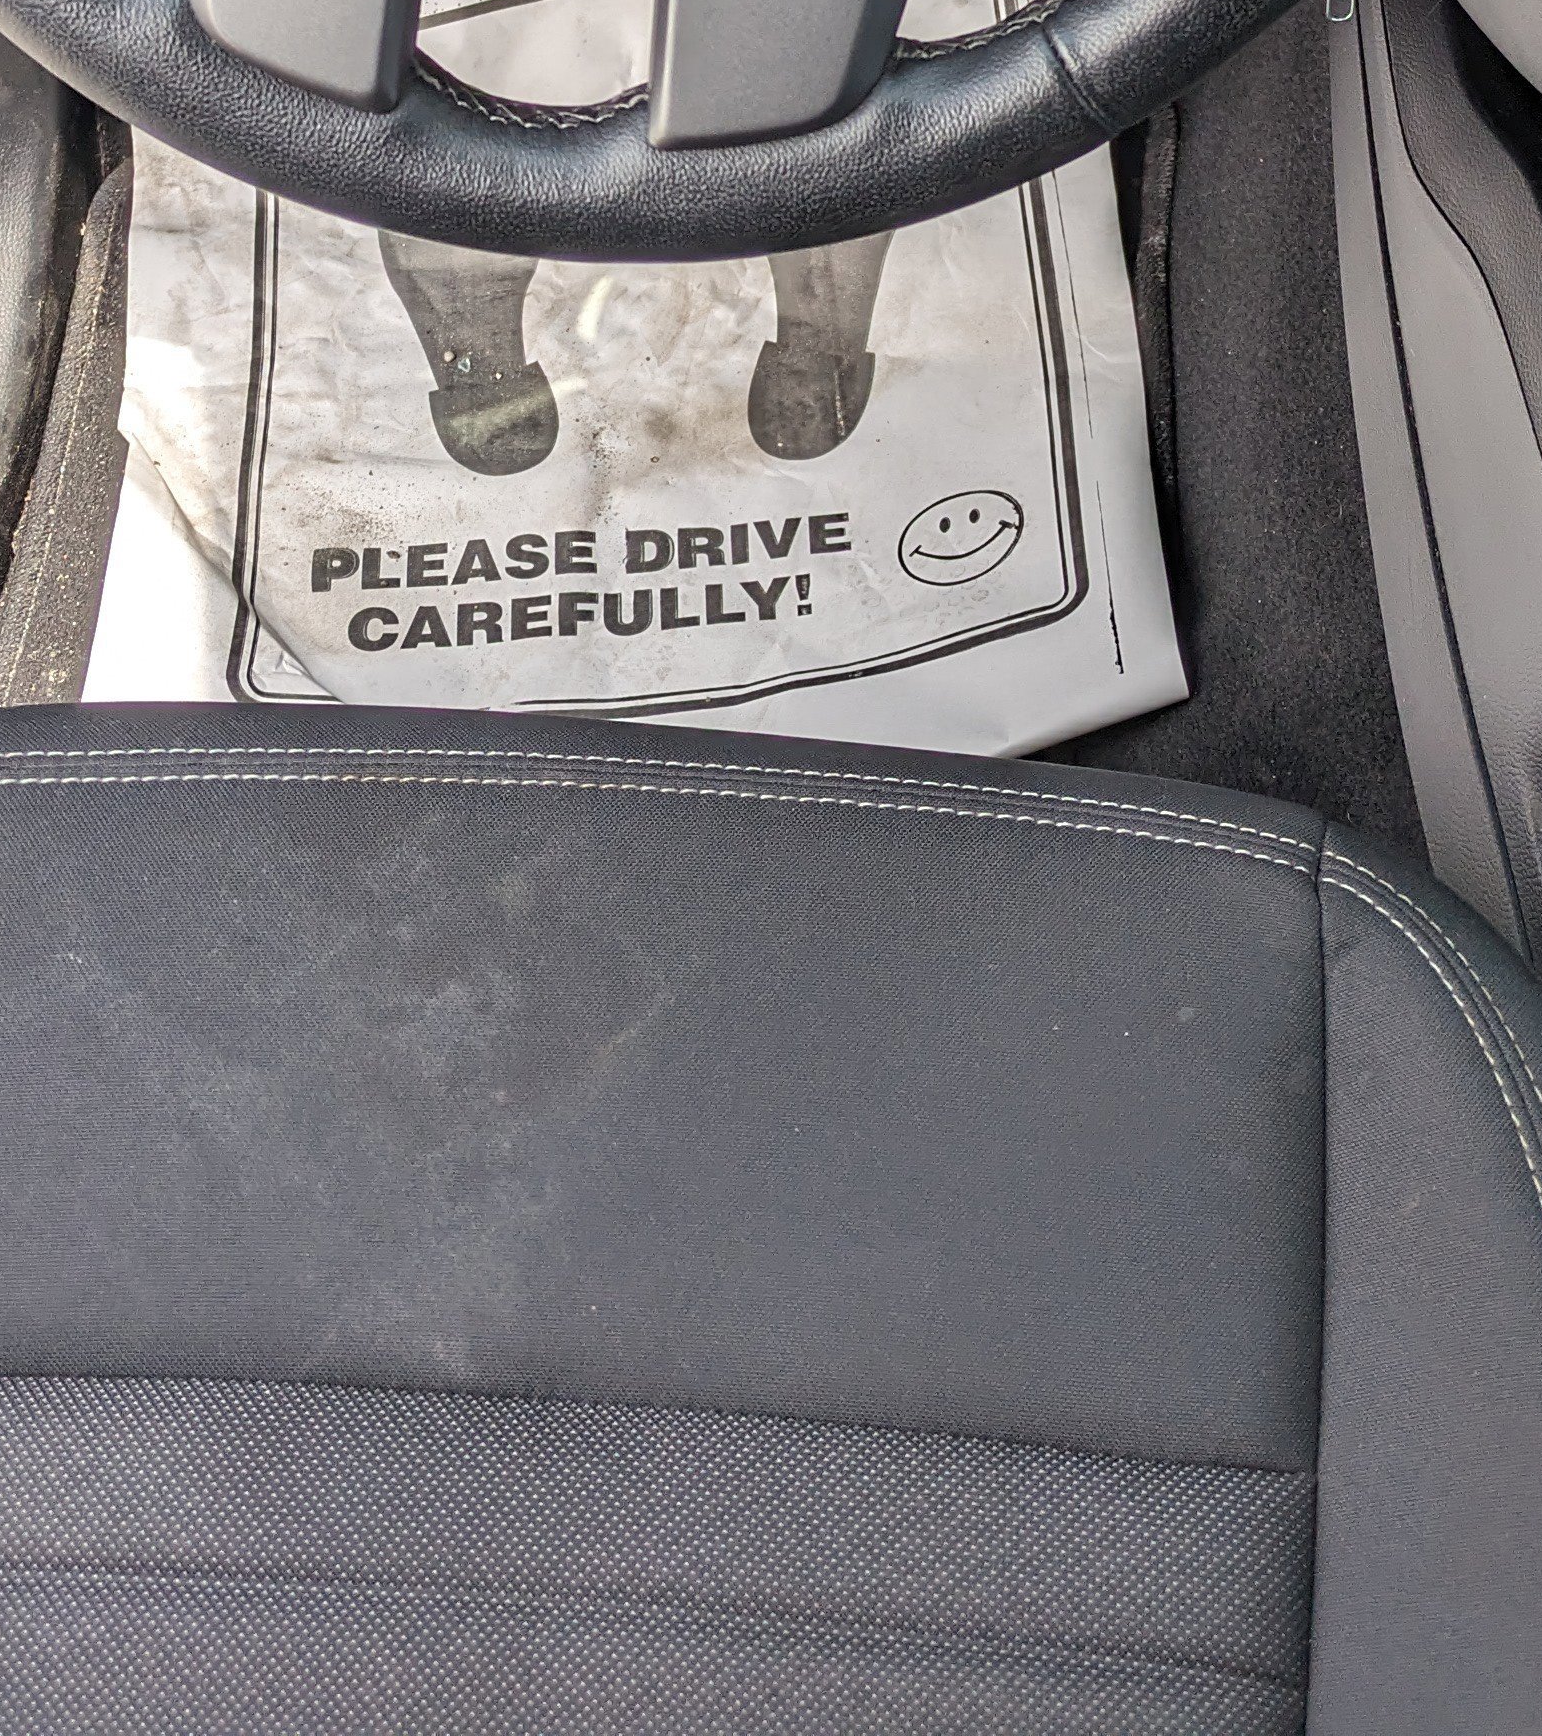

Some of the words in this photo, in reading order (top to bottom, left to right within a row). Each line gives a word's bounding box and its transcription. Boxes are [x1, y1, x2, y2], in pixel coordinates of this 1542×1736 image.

[311, 530, 598, 592] PLEASE
[623, 512, 852, 574] DRIVE
[347, 572, 813, 652] CAREFULLY!
